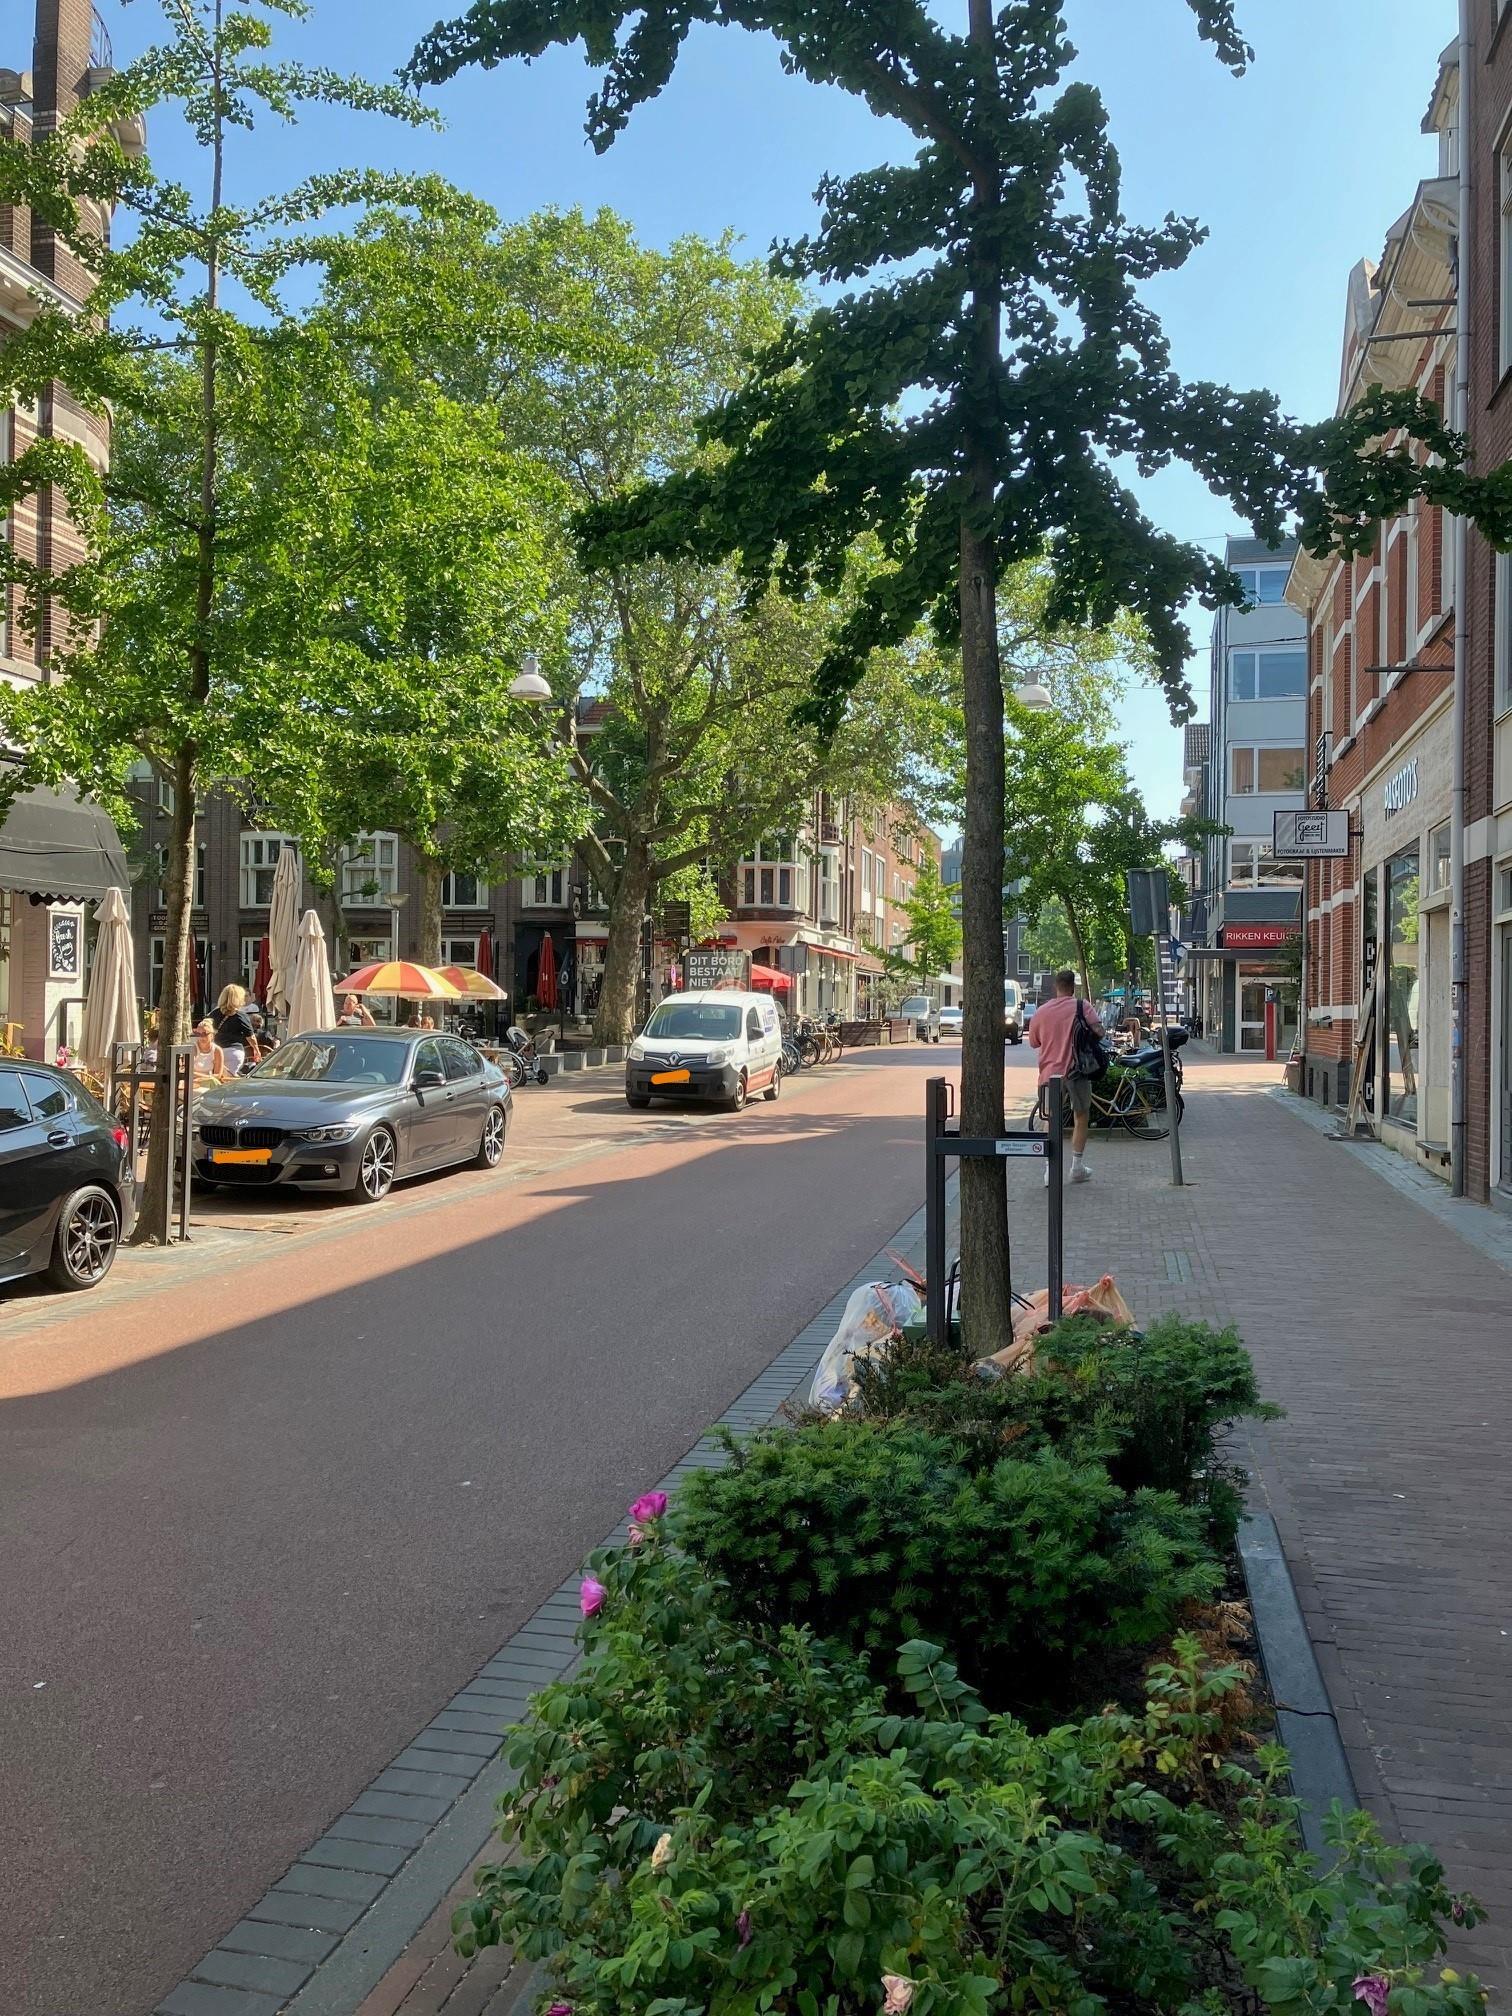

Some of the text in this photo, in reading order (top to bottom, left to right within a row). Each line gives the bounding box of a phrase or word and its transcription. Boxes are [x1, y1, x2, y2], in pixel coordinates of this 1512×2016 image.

[1226, 932, 1261, 940] RIKKEN
[689, 956, 743, 966] DIT BORD
[689, 967, 738, 976] BESTAAT
[688, 978, 715, 987] NIET
